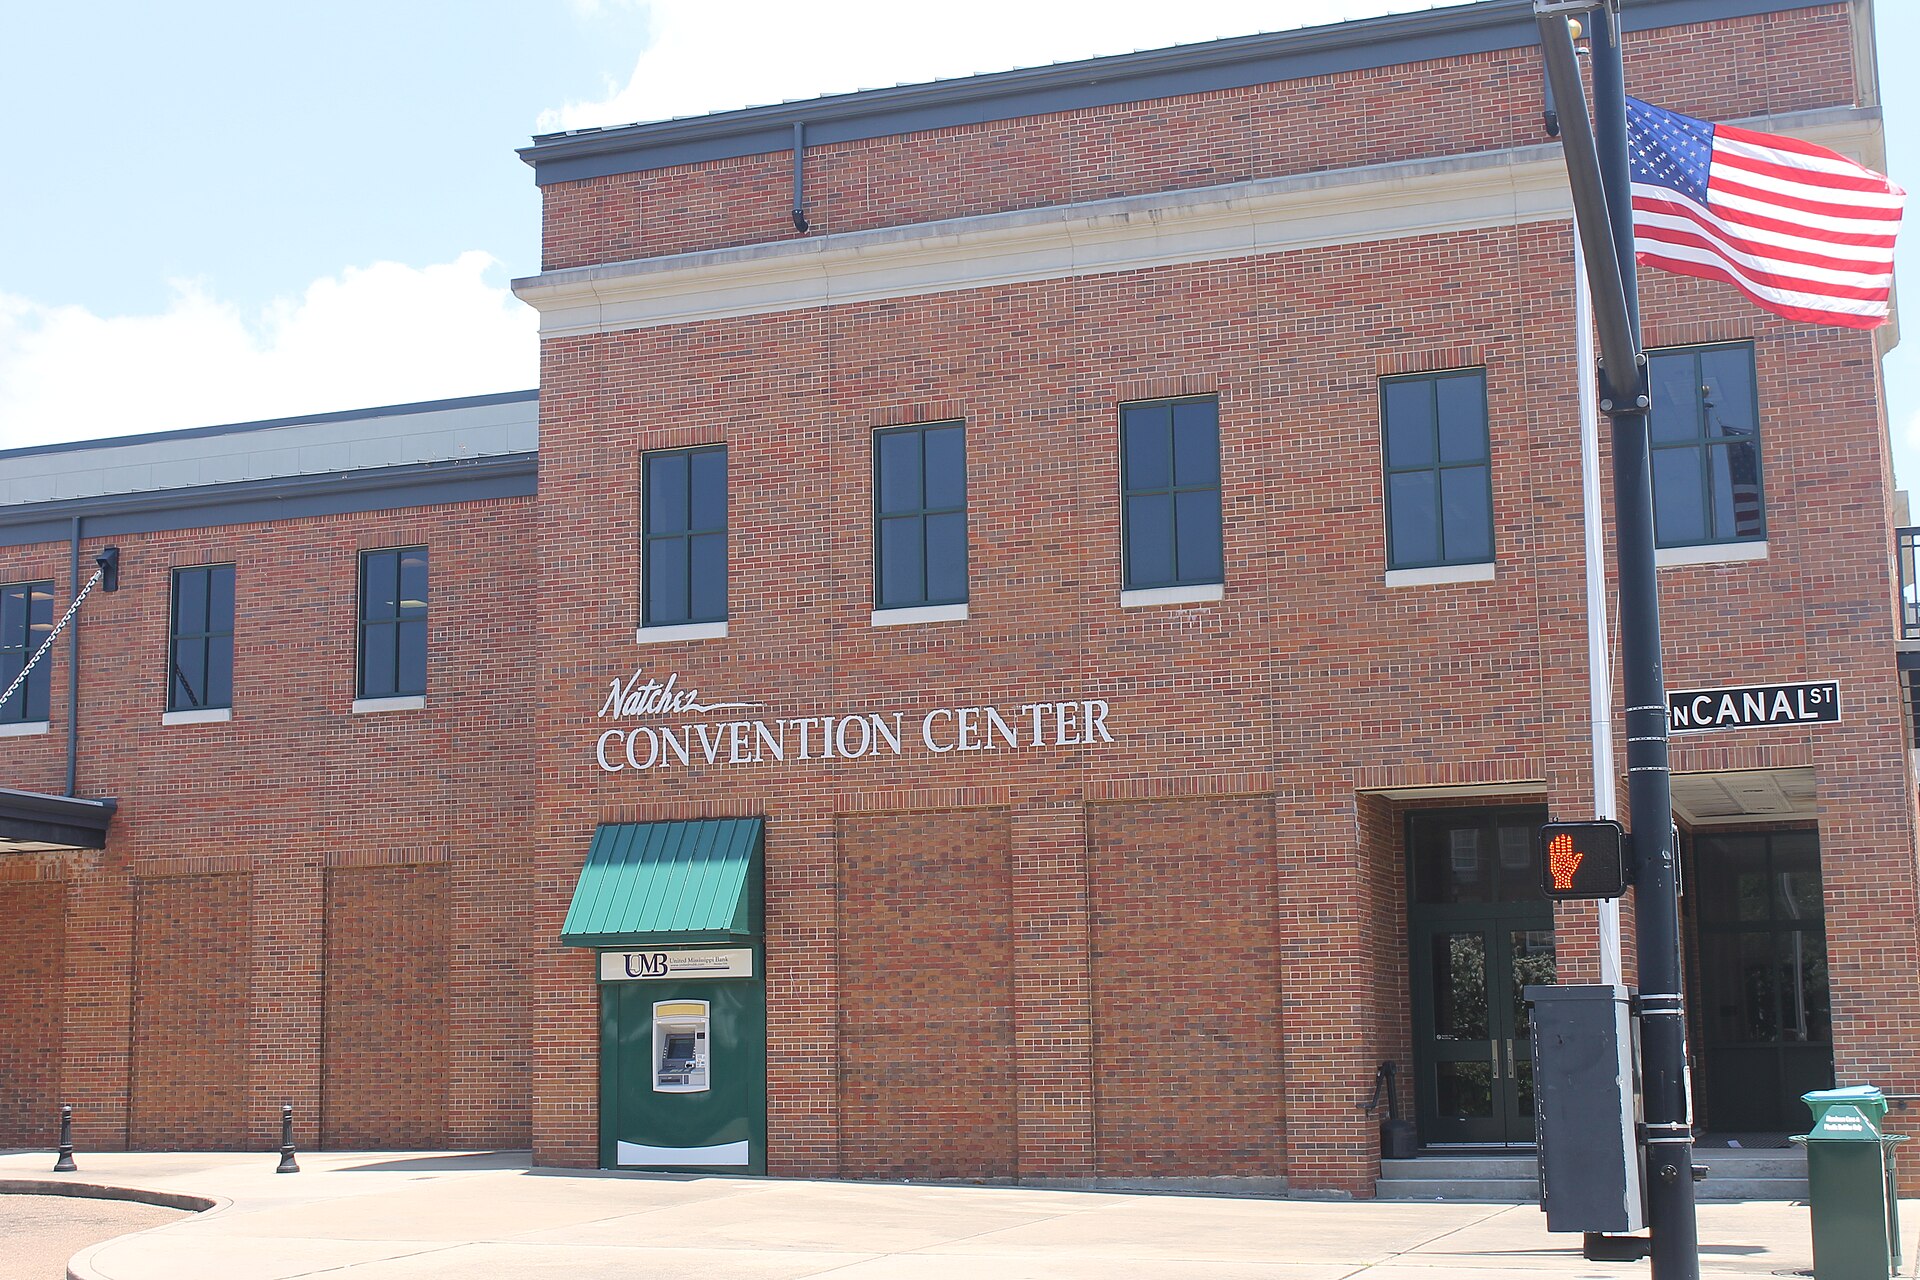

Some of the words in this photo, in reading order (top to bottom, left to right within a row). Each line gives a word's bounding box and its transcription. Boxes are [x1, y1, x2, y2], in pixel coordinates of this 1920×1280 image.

[597, 667, 767, 721] Natchez
[1673, 705, 1689, 727] N
[1691, 688, 1819, 726] CANAL
[1810, 687, 1833, 704] ST
[596, 711, 904, 773] CONVENTION
[922, 700, 1115, 753] CENTER
[623, 953, 669, 977] UMB
[688, 956, 714, 964] Mississippi
[715, 955, 728, 963] Bank
